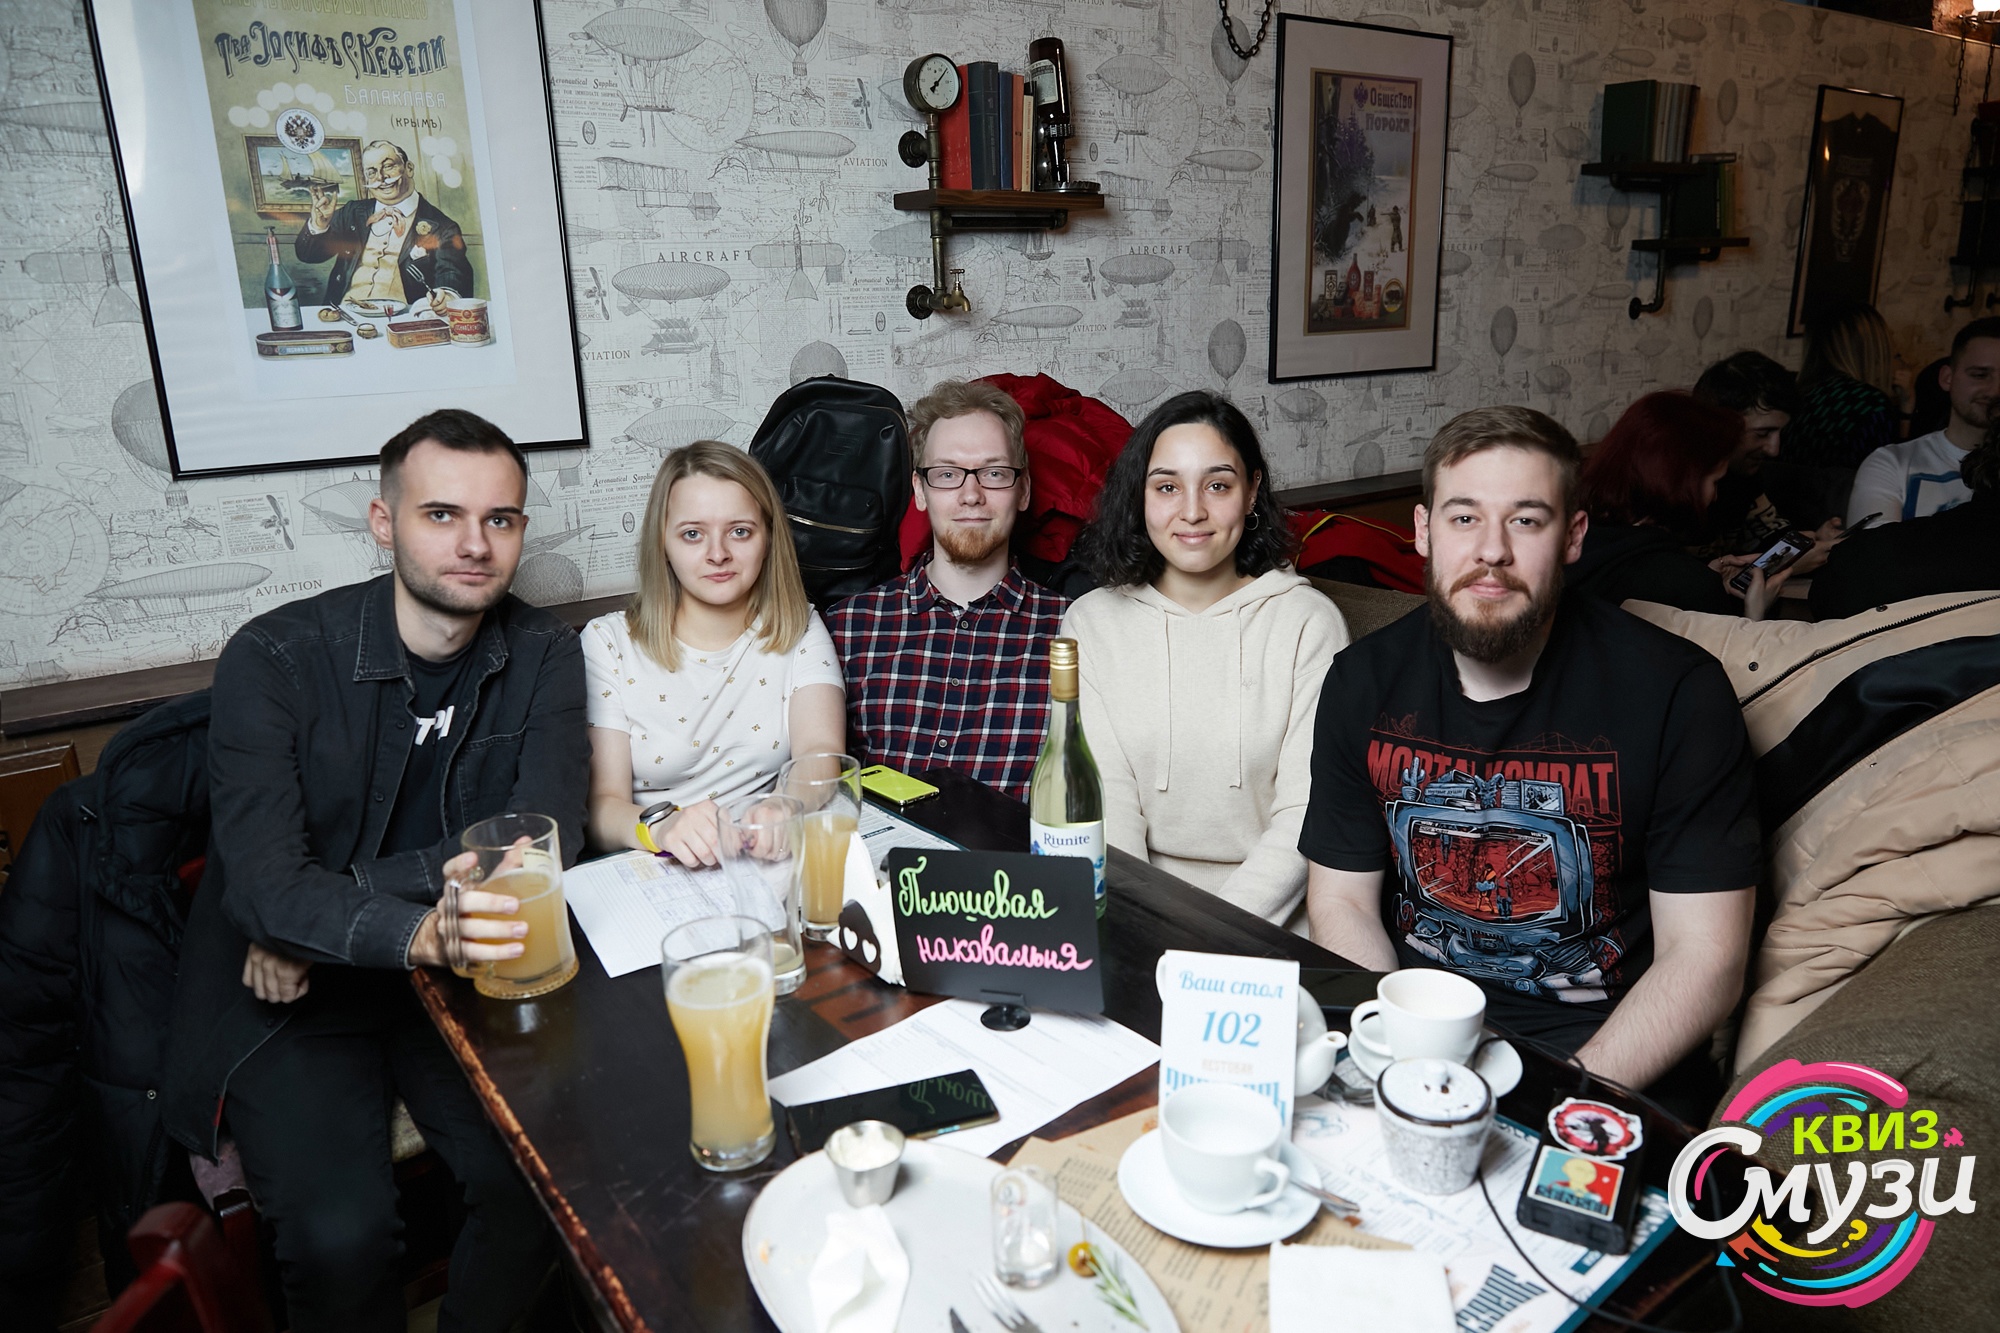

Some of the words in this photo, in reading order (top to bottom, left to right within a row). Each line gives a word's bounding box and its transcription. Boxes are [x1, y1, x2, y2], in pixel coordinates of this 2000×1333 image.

[593, 78, 618, 89] Supplies
[344, 84, 447, 108] БАЛАКЛАВА
[390, 113, 443, 132] (КРЫМЪ)
[843, 157, 888, 167] AVIATION
[1253, 170, 1273, 179] AVIAT
[1129, 245, 1190, 255] AIRCRAFT
[1446, 243, 1484, 252] IRCRAFT
[658, 250, 752, 263] AIRCRAFT
[1072, 324, 1108, 333] AVIATION
[580, 350, 631, 362] AVIATION
[592, 475, 628, 488] Aeronautical
[255, 579, 323, 597] AVIATION
[1043, 831, 1090, 848] Riunite
[897, 855, 1059, 922] Плюшевая
[916, 923, 1094, 973] наковальня
[1178, 969, 1226, 993] Ваш
[1229, 979, 1284, 1000] стол
[1202, 1009, 1262, 1048] 102
